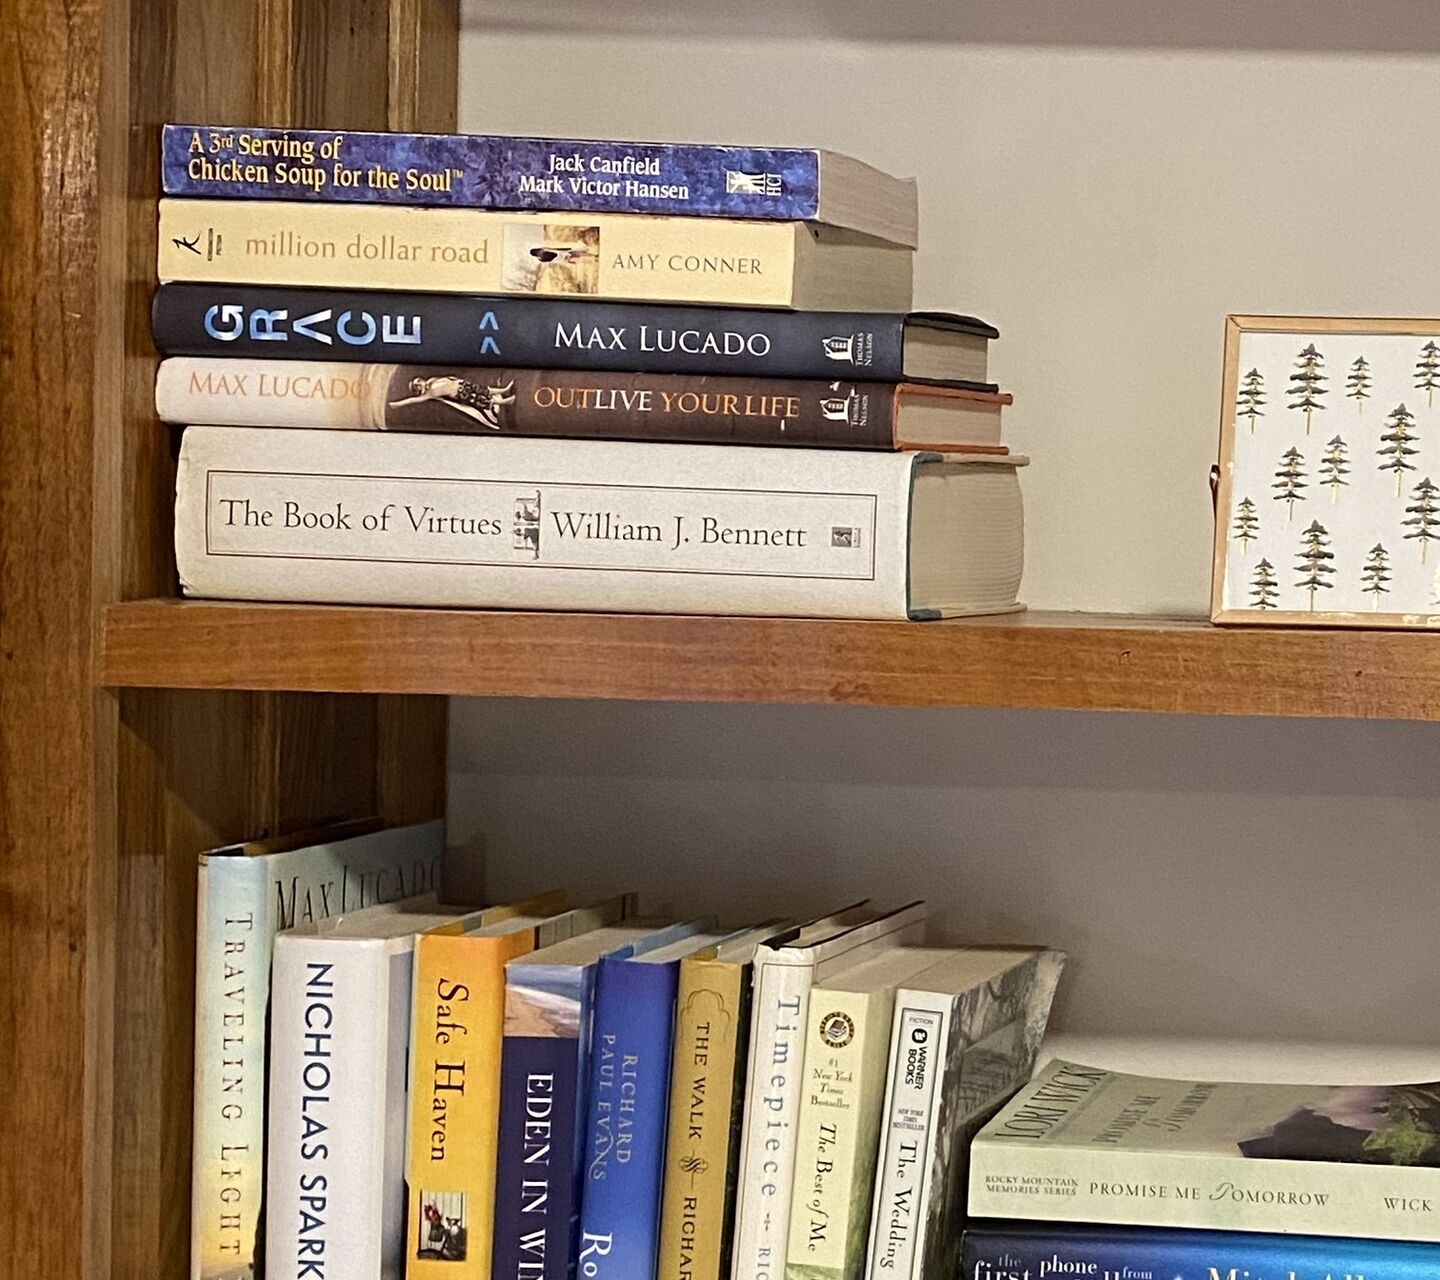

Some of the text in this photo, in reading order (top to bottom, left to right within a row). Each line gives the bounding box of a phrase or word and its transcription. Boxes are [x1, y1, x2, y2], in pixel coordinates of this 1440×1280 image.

[188, 133, 343, 164] A 3rd Serving of
[548, 154, 660, 179] Jack Canfield
[188, 158, 269, 185] Chicken
[274, 161, 326, 191] Soup
[332, 164, 361, 188] for
[367, 166, 399, 191] the
[520, 175, 690, 200] Mark Victor Hansen
[245, 228, 336, 258] million
[345, 231, 421, 261] dollar
[429, 238, 489, 264] road
[612, 253, 763, 275] AMY CONNER
[204, 302, 422, 346] GRACE
[554, 321, 772, 357] MAX LUCADO
[187, 371, 372, 399] MAX LUCADO
[533, 386, 801, 418] OUTLIVE YOUR LIFE
[219, 498, 502, 536] The Book of Virtues
[550, 510, 808, 553] William J. Bennett
[299, 962, 335, 1161] NICHOLAS
[693, 1021, 711, 1069] THE
[904, 1048, 918, 1085] BOOKS
[218, 911, 254, 1255] TRAVELING LIGHT
[429, 977, 470, 1162] Safe Haven
[913, 1046, 929, 1091] WARNER
[587, 1034, 618, 1182] PAUL EVANS
[615, 1053, 639, 1165] RICHARD
[687, 1076, 706, 1140] WALK
[760, 995, 801, 1198] Timepiece
[994, 1065, 1107, 1140] LORI WICK
[520, 1072, 555, 1167] EDEN
[520, 1178, 549, 1215] IN
[806, 1122, 838, 1252] The Best of Me
[880, 1139, 919, 1270] The Wedding
[1089, 1181, 1433, 1213] PROMISE ME TOMORROW WICK
[998, 1253, 1022, 1268] the
[1039, 1254, 1098, 1278] phone
[1122, 1266, 1153, 1280] from
